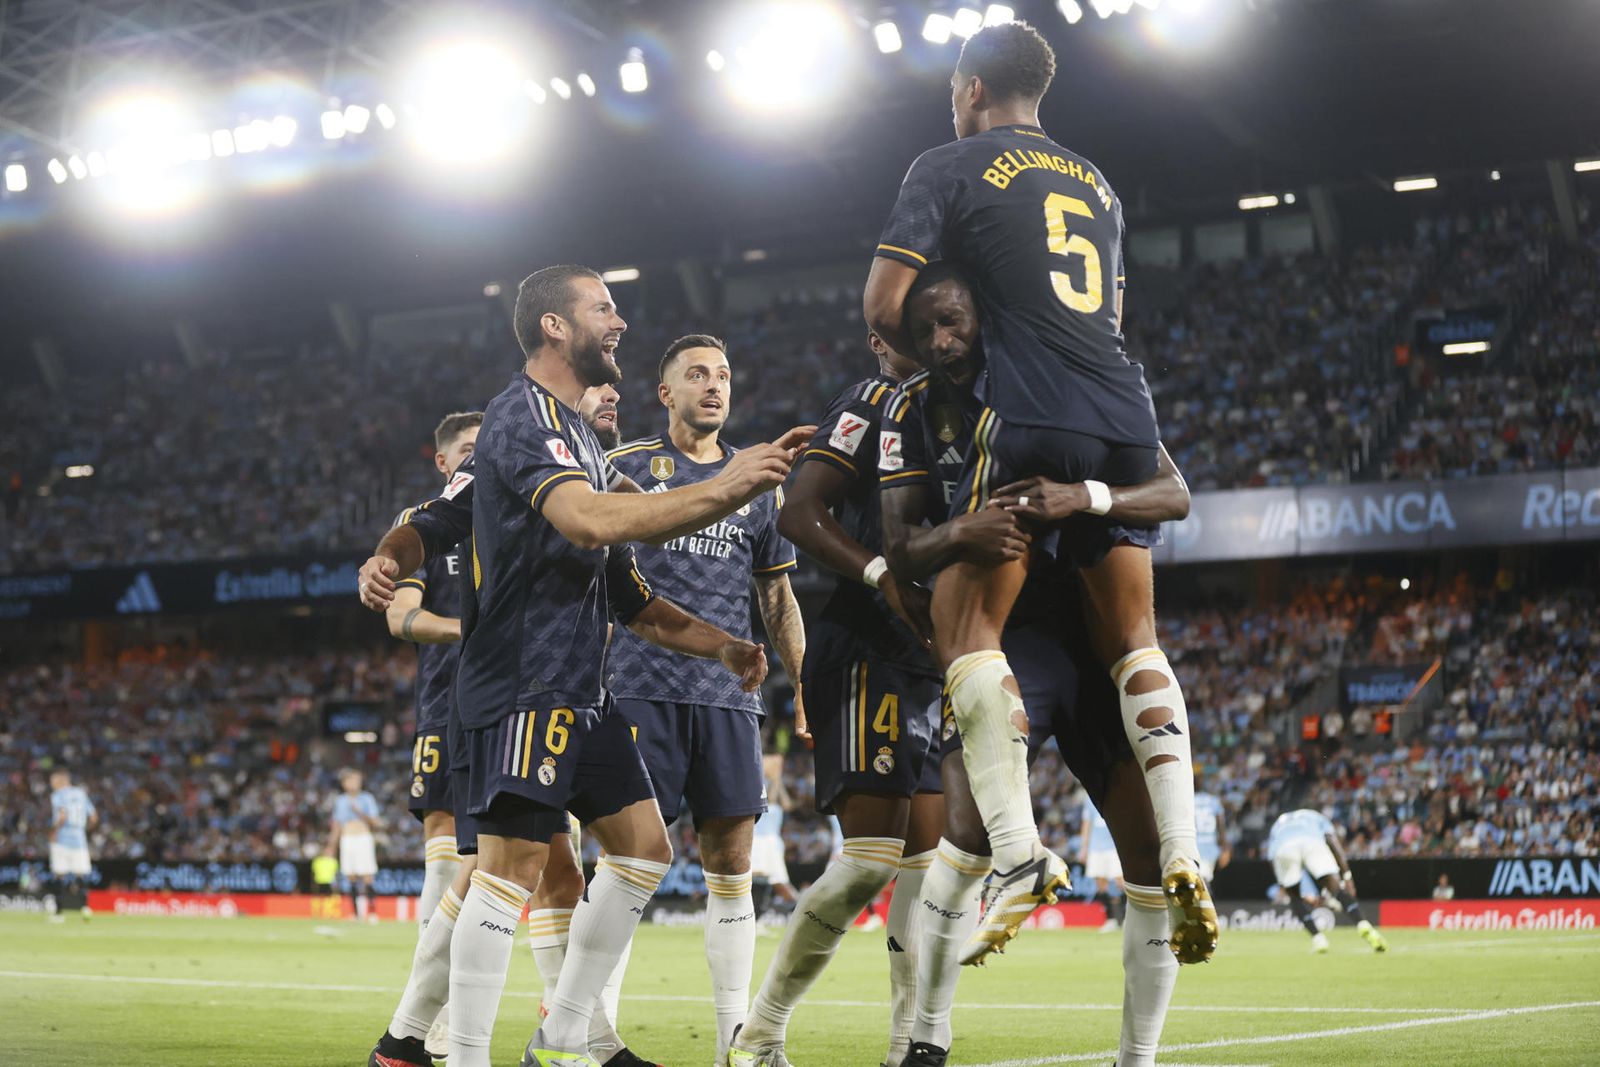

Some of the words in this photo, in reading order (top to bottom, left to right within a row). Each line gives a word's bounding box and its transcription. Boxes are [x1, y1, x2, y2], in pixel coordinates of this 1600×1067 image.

[982, 149, 1112, 212] BELLINGHAM
[1044, 192, 1103, 314] 5
[688, 536, 732, 558] BETTER
[545, 707, 575, 755] 6
[872, 693, 900, 742] 4
[413, 735, 441, 774] 15
[923, 900, 968, 919] RMCF
[1429, 908, 1513, 931] Estrella
[1516, 907, 1596, 930] Galicia
